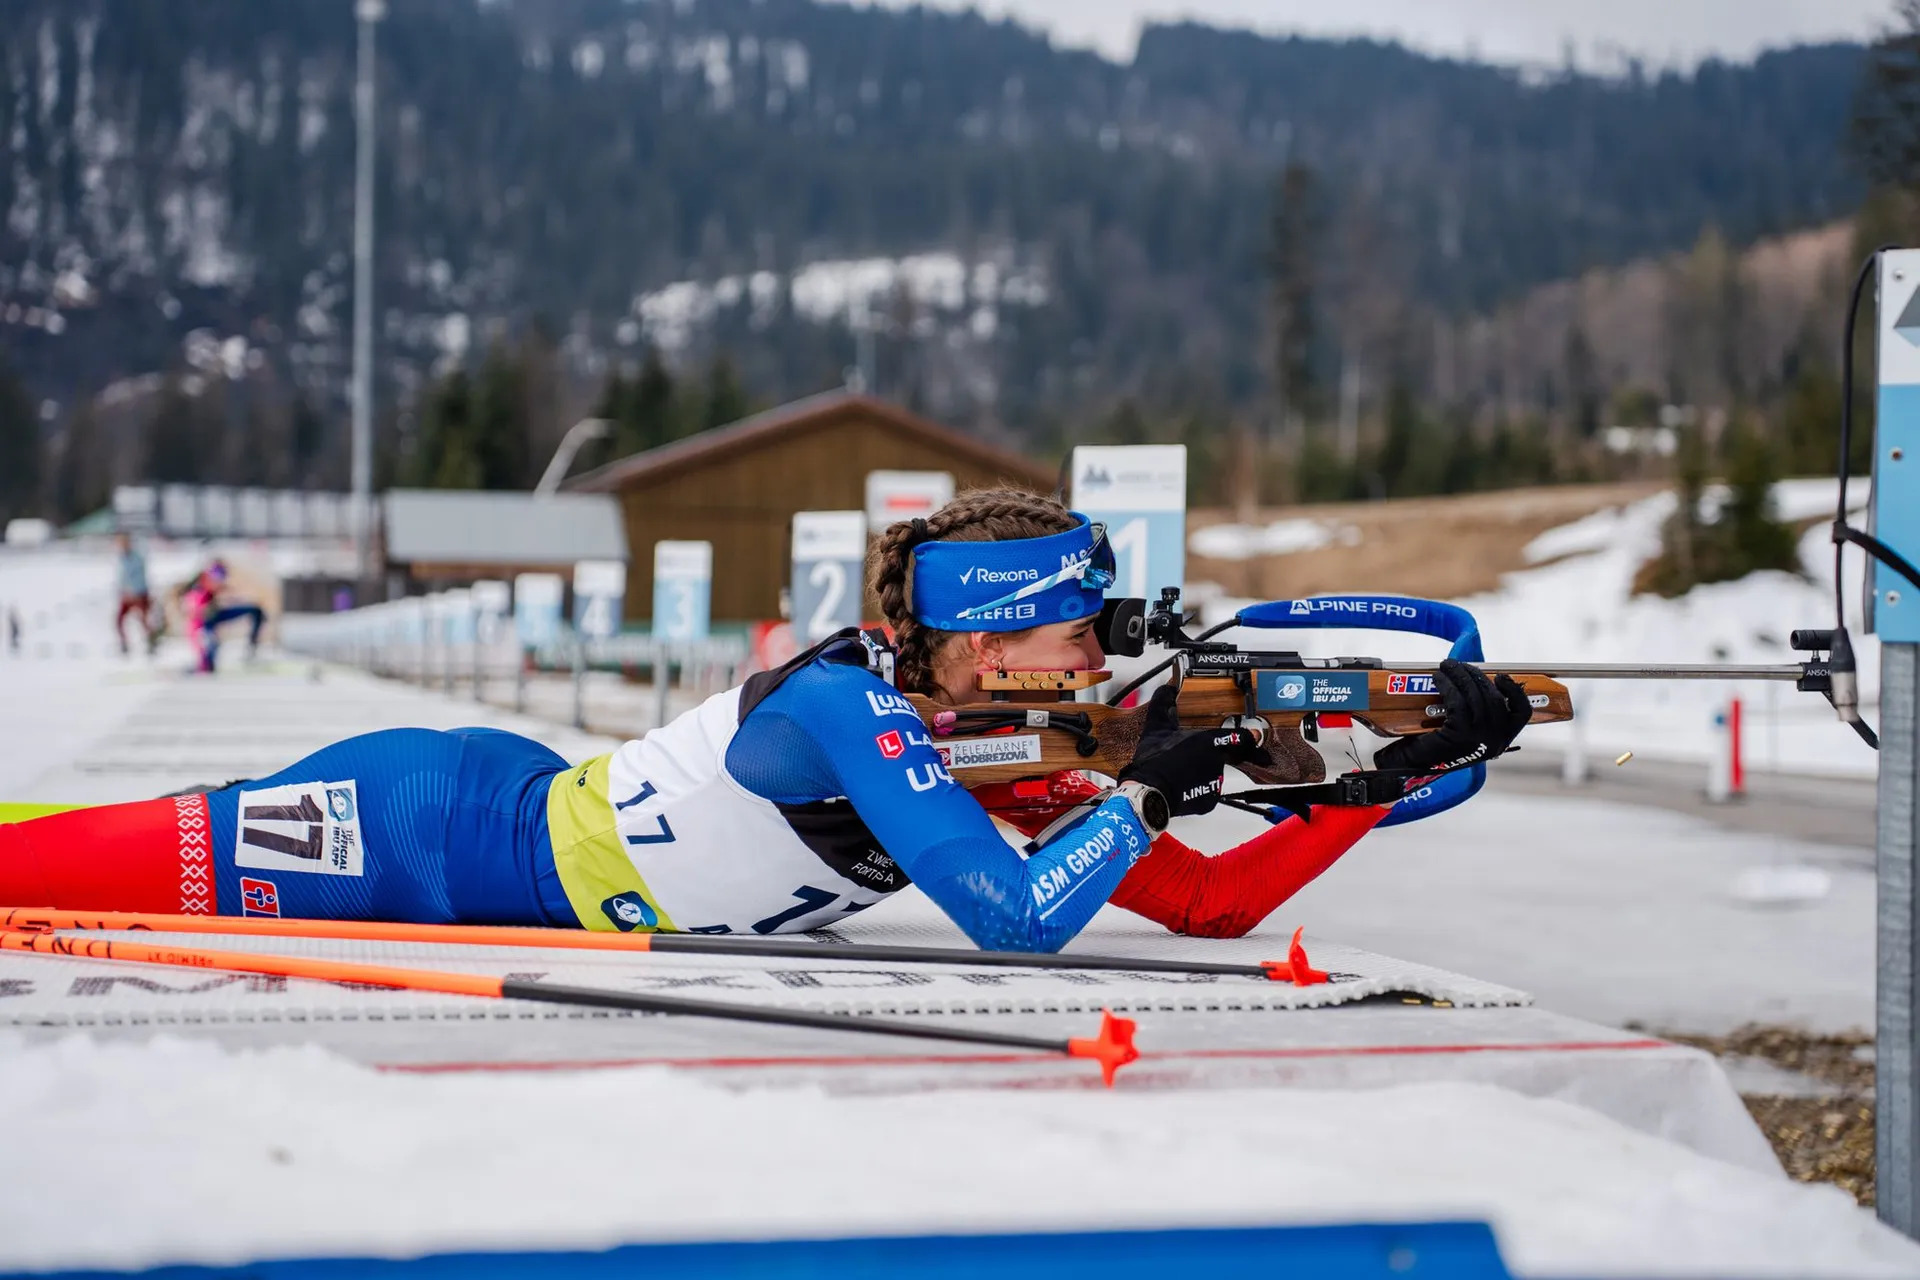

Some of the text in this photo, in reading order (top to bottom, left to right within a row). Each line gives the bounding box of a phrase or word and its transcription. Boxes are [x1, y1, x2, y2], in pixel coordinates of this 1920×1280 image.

[1112, 518, 1148, 600] 1
[976, 568, 1039, 584] Rexona
[808, 561, 847, 635] 2
[1290, 599, 1418, 619] ALPINE PRO
[1197, 654, 1250, 664] ANSCHUTZ
[1312, 679, 1328, 687] THE
[1312, 687, 1352, 695] OFFICIAL
[1312, 695, 1349, 703] IBU APP
[615, 780, 676, 845] 17
[242, 794, 324, 860] 17
[1065, 827, 1115, 875] GROUP
